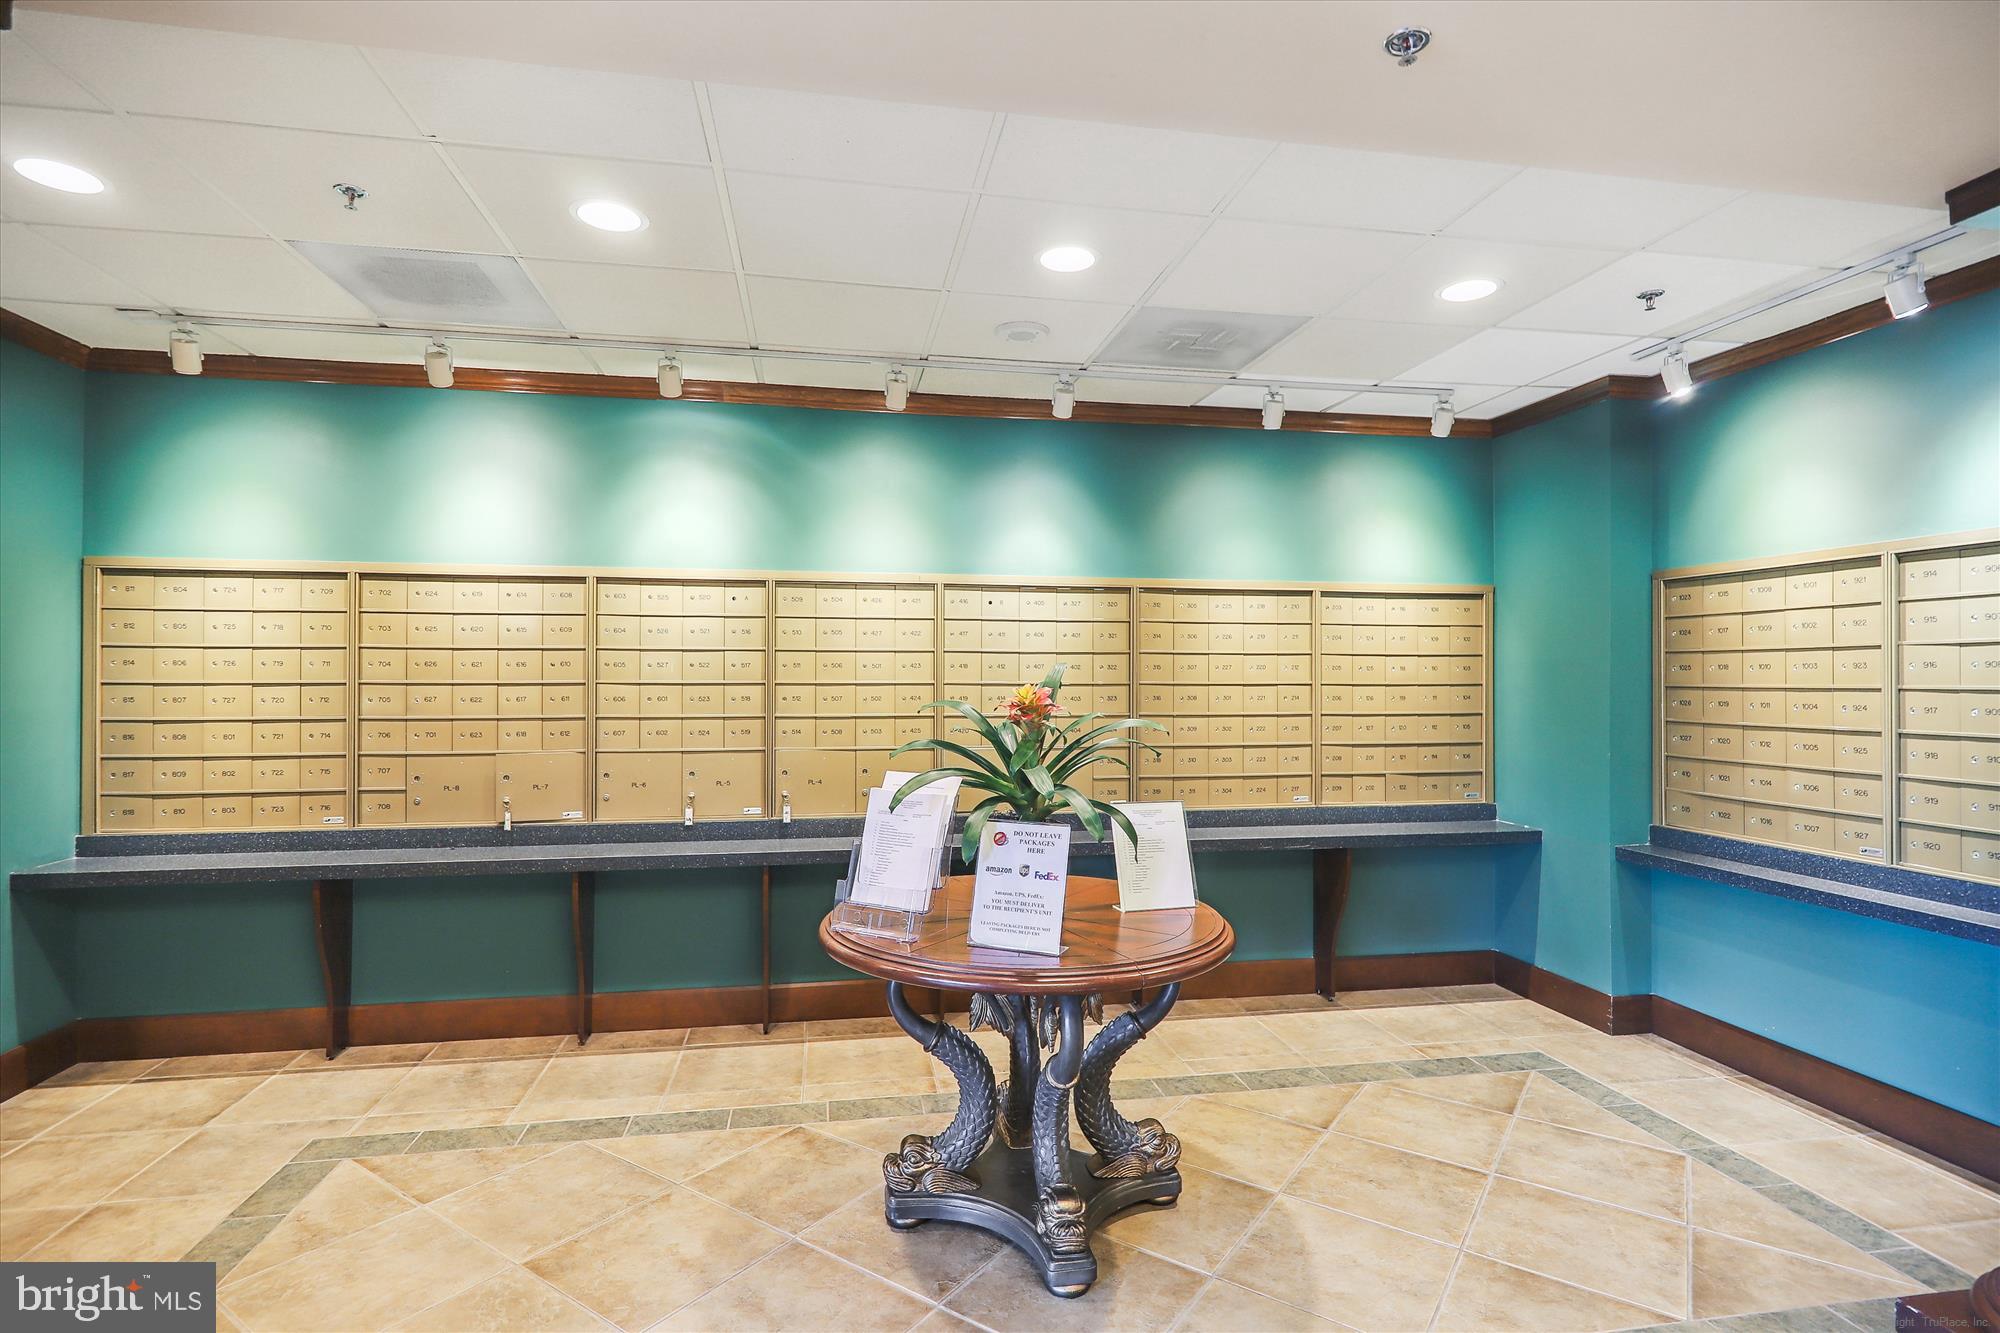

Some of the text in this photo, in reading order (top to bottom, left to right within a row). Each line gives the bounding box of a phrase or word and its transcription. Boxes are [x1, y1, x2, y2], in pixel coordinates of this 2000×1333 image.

[1922, 570, 1937, 578] 914
[1923, 616, 1938, 624] 915
[1852, 662, 1868, 670] 923
[1759, 740, 1772, 749] 1012
[1802, 743, 1819, 752] 1005
[1853, 746, 1868, 755] 925
[1924, 751, 1939, 760] 918
[1803, 784, 1820, 792] 1006
[1853, 789, 1869, 798] 926
[1924, 796, 1939, 806] 919
[1718, 811, 1731, 820] 1022
[1760, 817, 1773, 826] 1016
[1804, 824, 1820, 833] 1007
[1854, 831, 1869, 840] 927
[1923, 841, 1941, 851] 920
[986, 865, 1012, 874] amazon
[1034, 871, 1059, 881] FedEx
